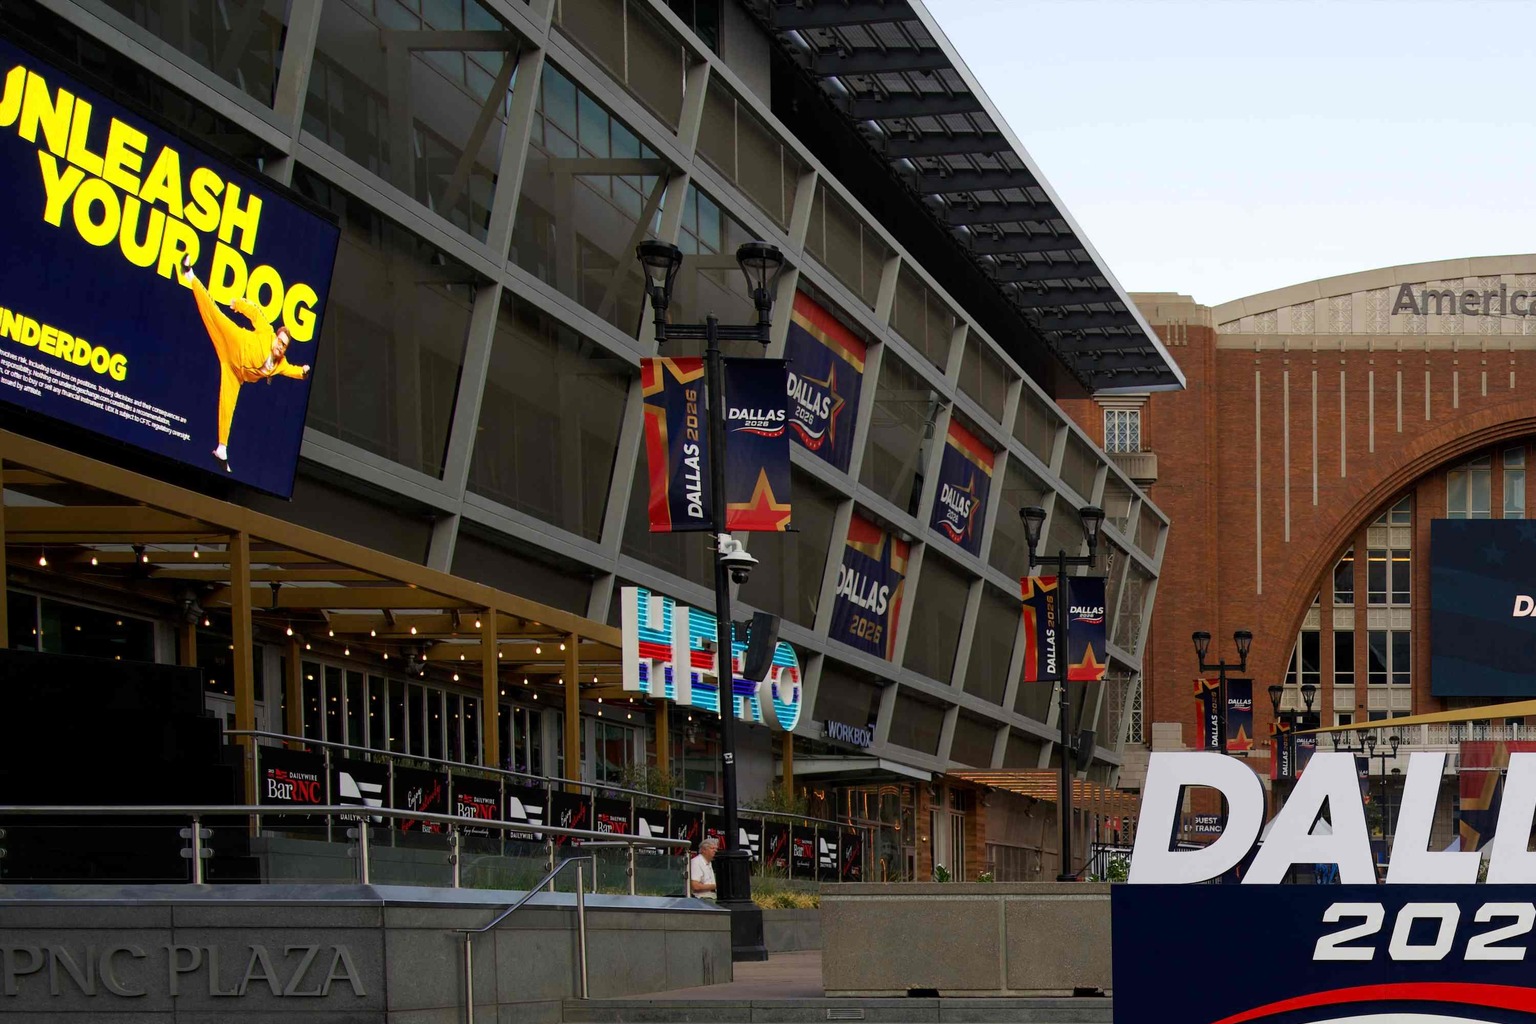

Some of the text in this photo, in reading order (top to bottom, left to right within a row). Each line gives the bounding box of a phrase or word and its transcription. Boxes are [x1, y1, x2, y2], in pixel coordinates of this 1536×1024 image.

[38, 149, 318, 342] YOUR DOG
[0, 306, 128, 381] NDERDOG
[787, 371, 831, 420] DALLAS
[728, 407, 786, 422] DALLAS
[794, 405, 815, 426] 2026
[684, 389, 704, 519] DALLAS 2026
[941, 483, 971, 519] DALLAS
[946, 508, 959, 524] 2026
[1070, 606, 1104, 614] DALLAS
[850, 614, 882, 644] 2026
[1046, 595, 1056, 674] DALLAS 2026
[828, 720, 872, 748] WORKBOX
[1211, 714, 1219, 747] DALLAS
[289, 771, 318, 781] DAILYWIRE
[0, 944, 367, 997] PNC PLAZA
